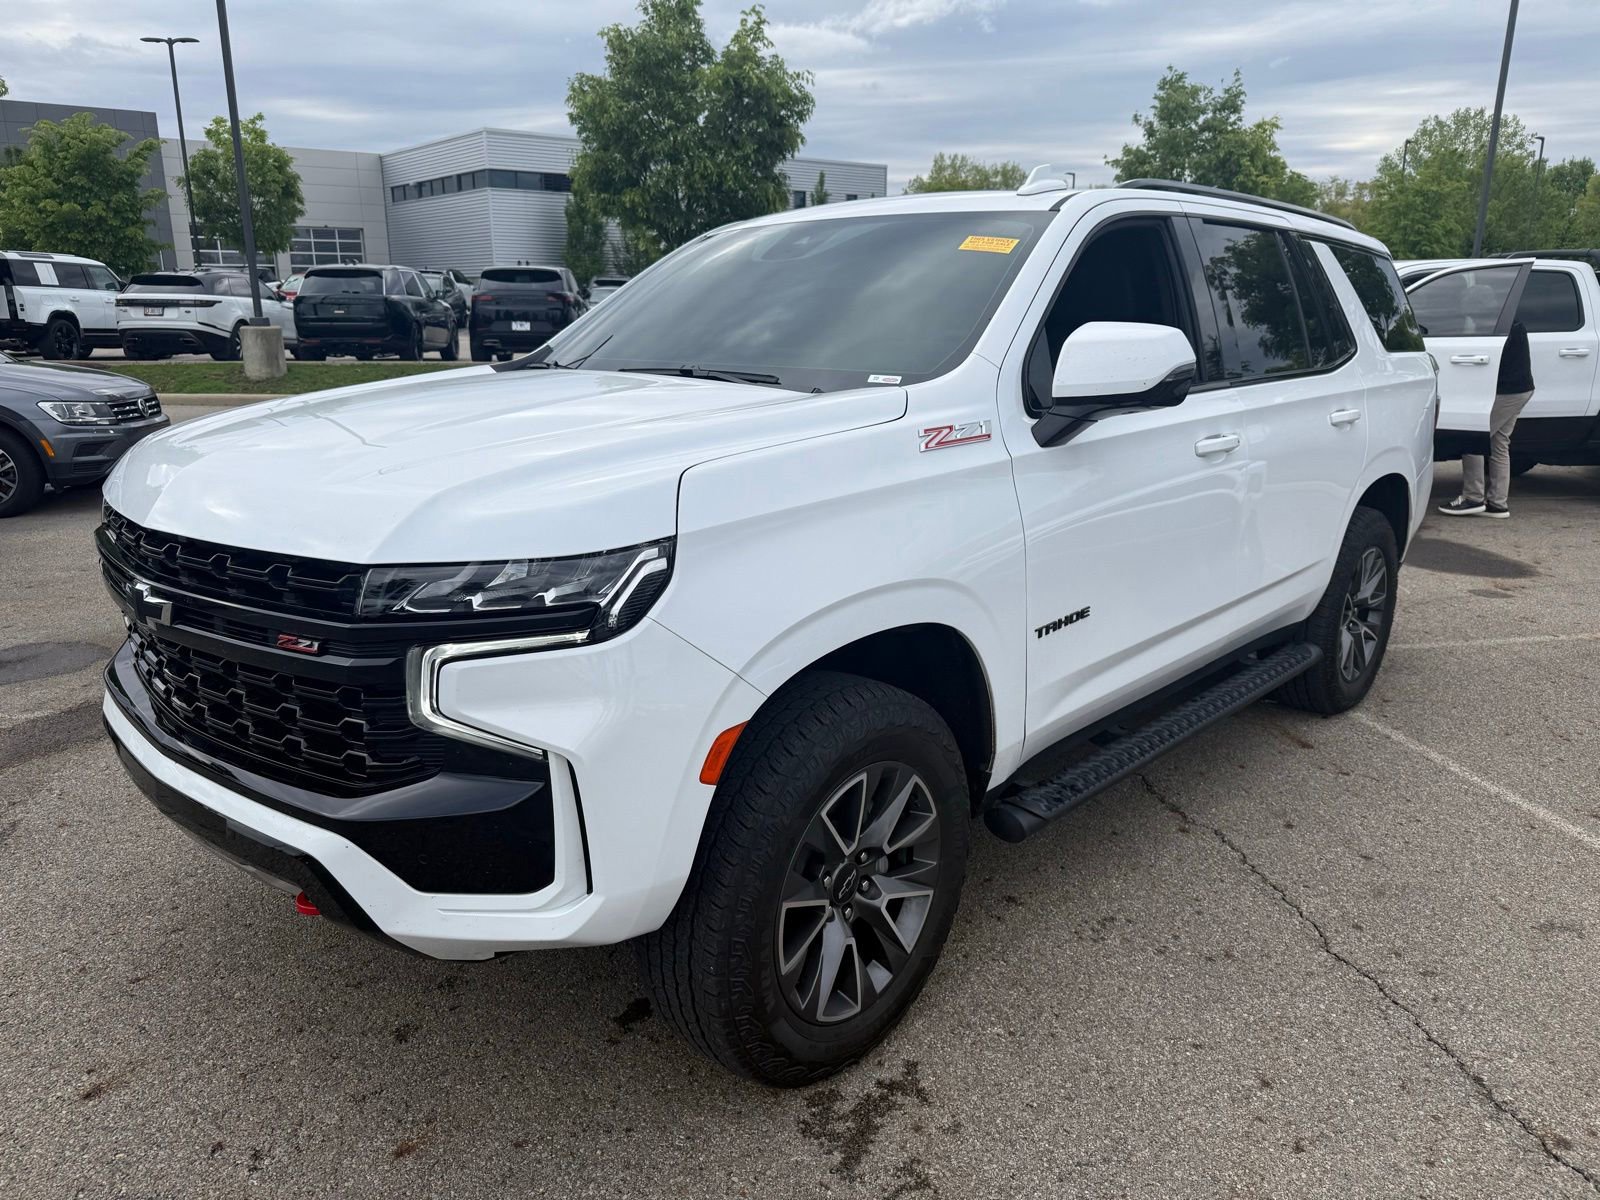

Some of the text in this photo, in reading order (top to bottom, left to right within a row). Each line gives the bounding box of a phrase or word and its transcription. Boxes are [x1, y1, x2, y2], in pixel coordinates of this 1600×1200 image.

[918, 420, 991, 453] Z71
[1035, 606, 1091, 639] TAHOE
[277, 634, 320, 653] Z71
